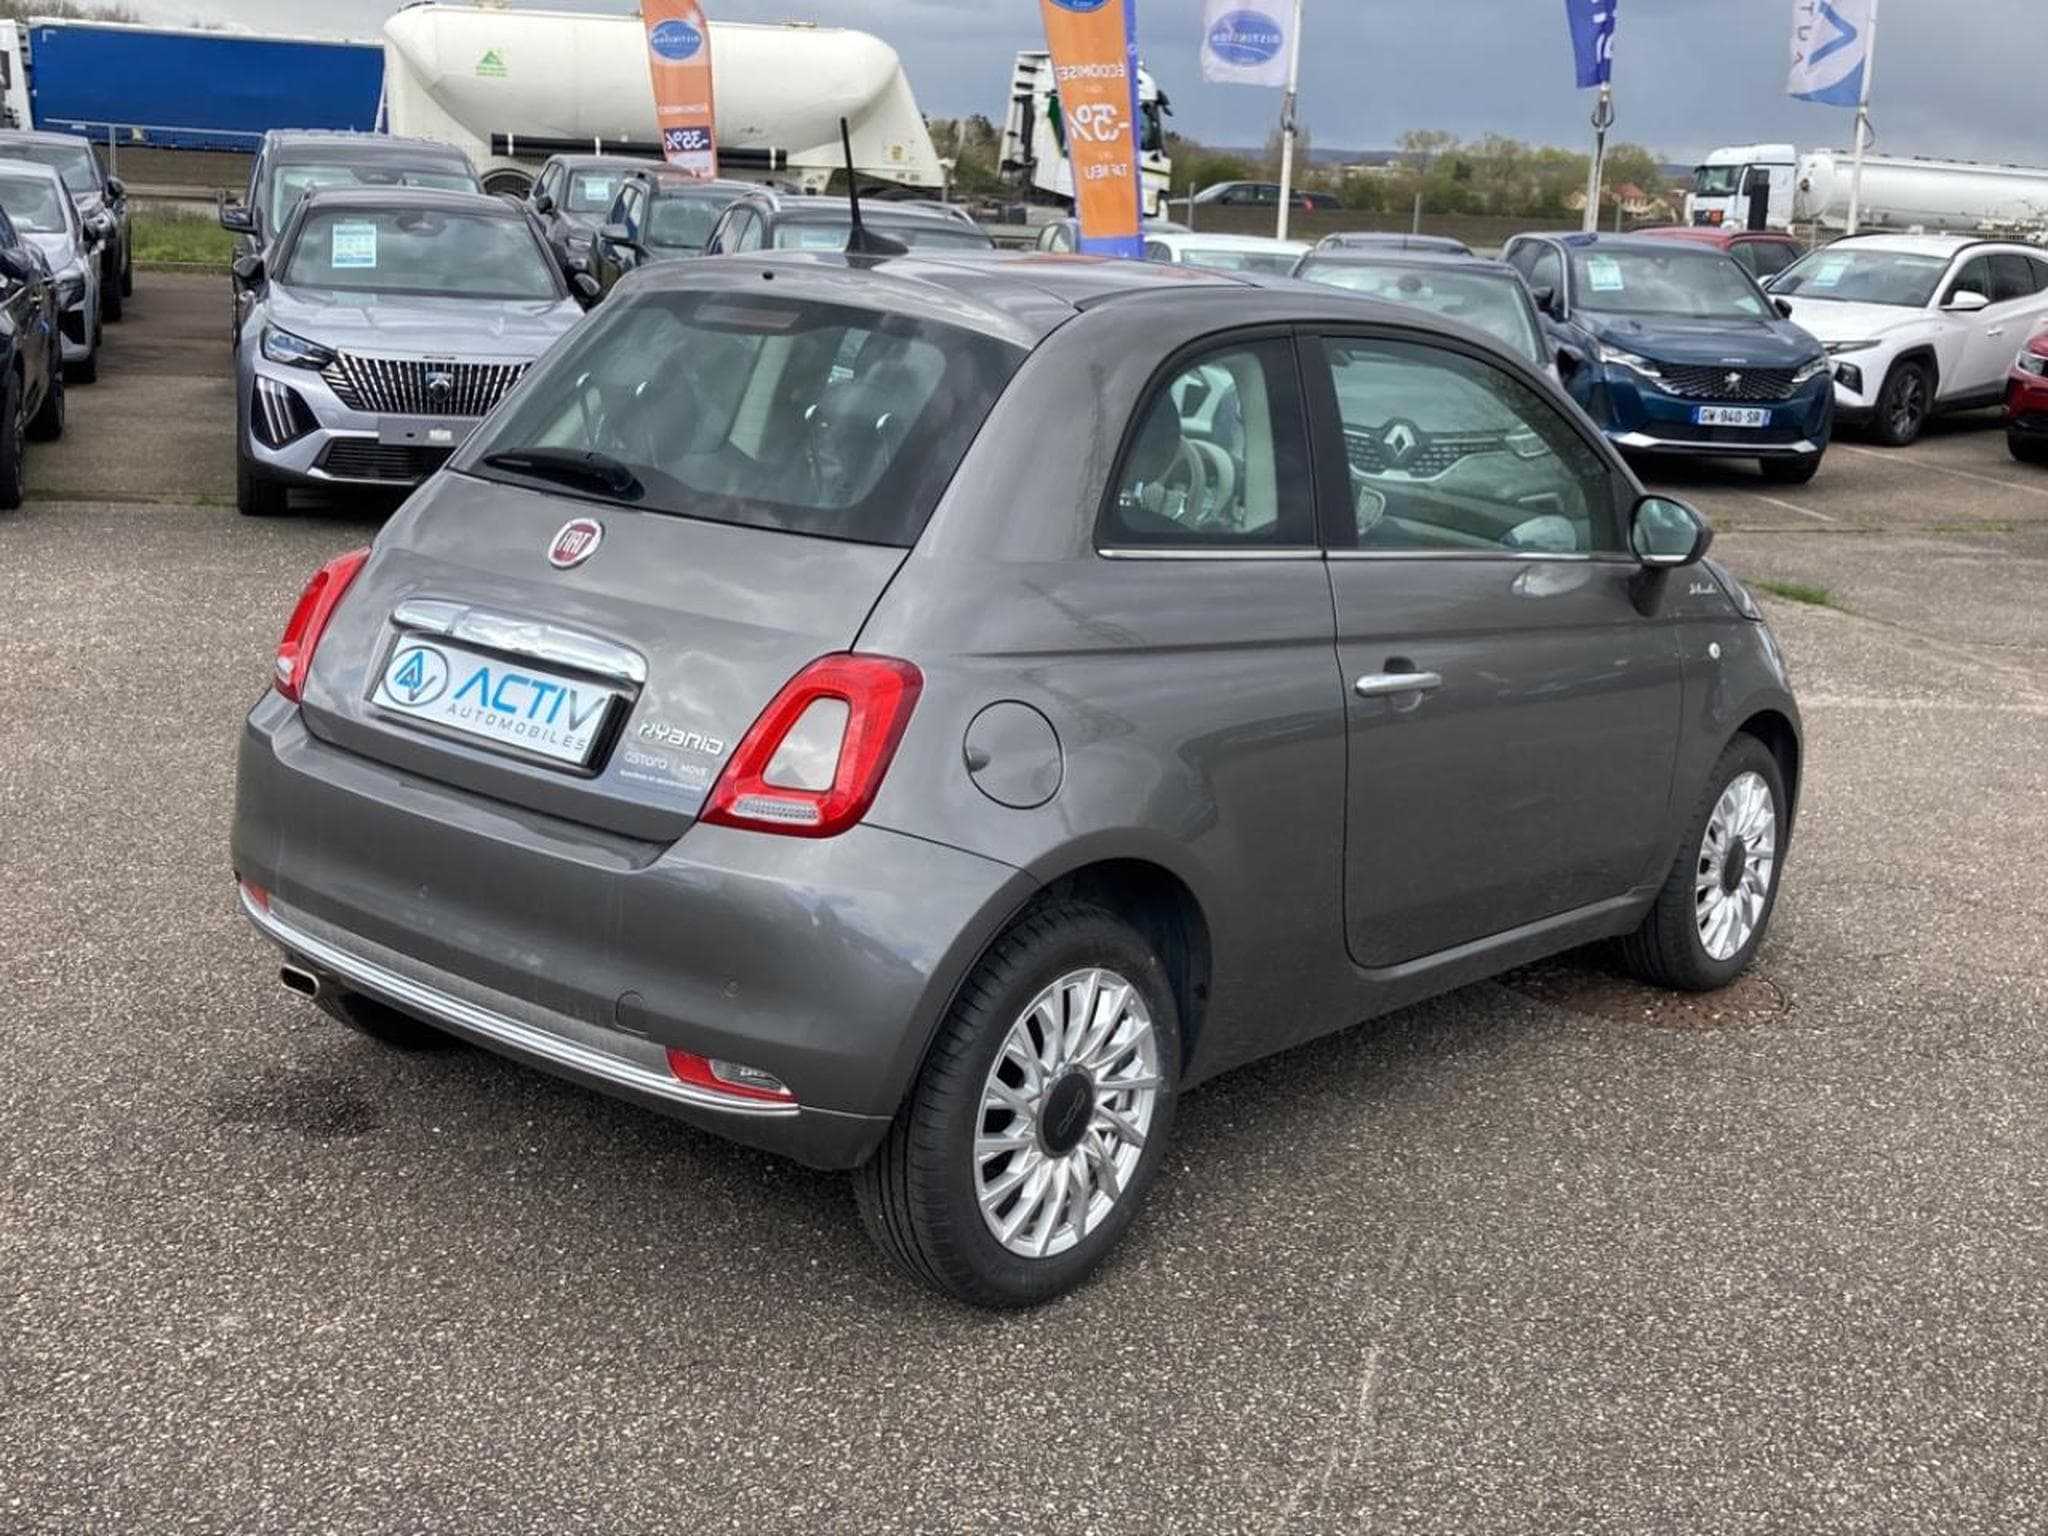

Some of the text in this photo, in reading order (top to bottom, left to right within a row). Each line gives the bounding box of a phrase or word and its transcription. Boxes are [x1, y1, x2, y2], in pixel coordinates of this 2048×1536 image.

[557, 529, 593, 555] FIAT
[453, 667, 607, 732] ACTIV
[446, 703, 586, 751] AUTOMOBILES
